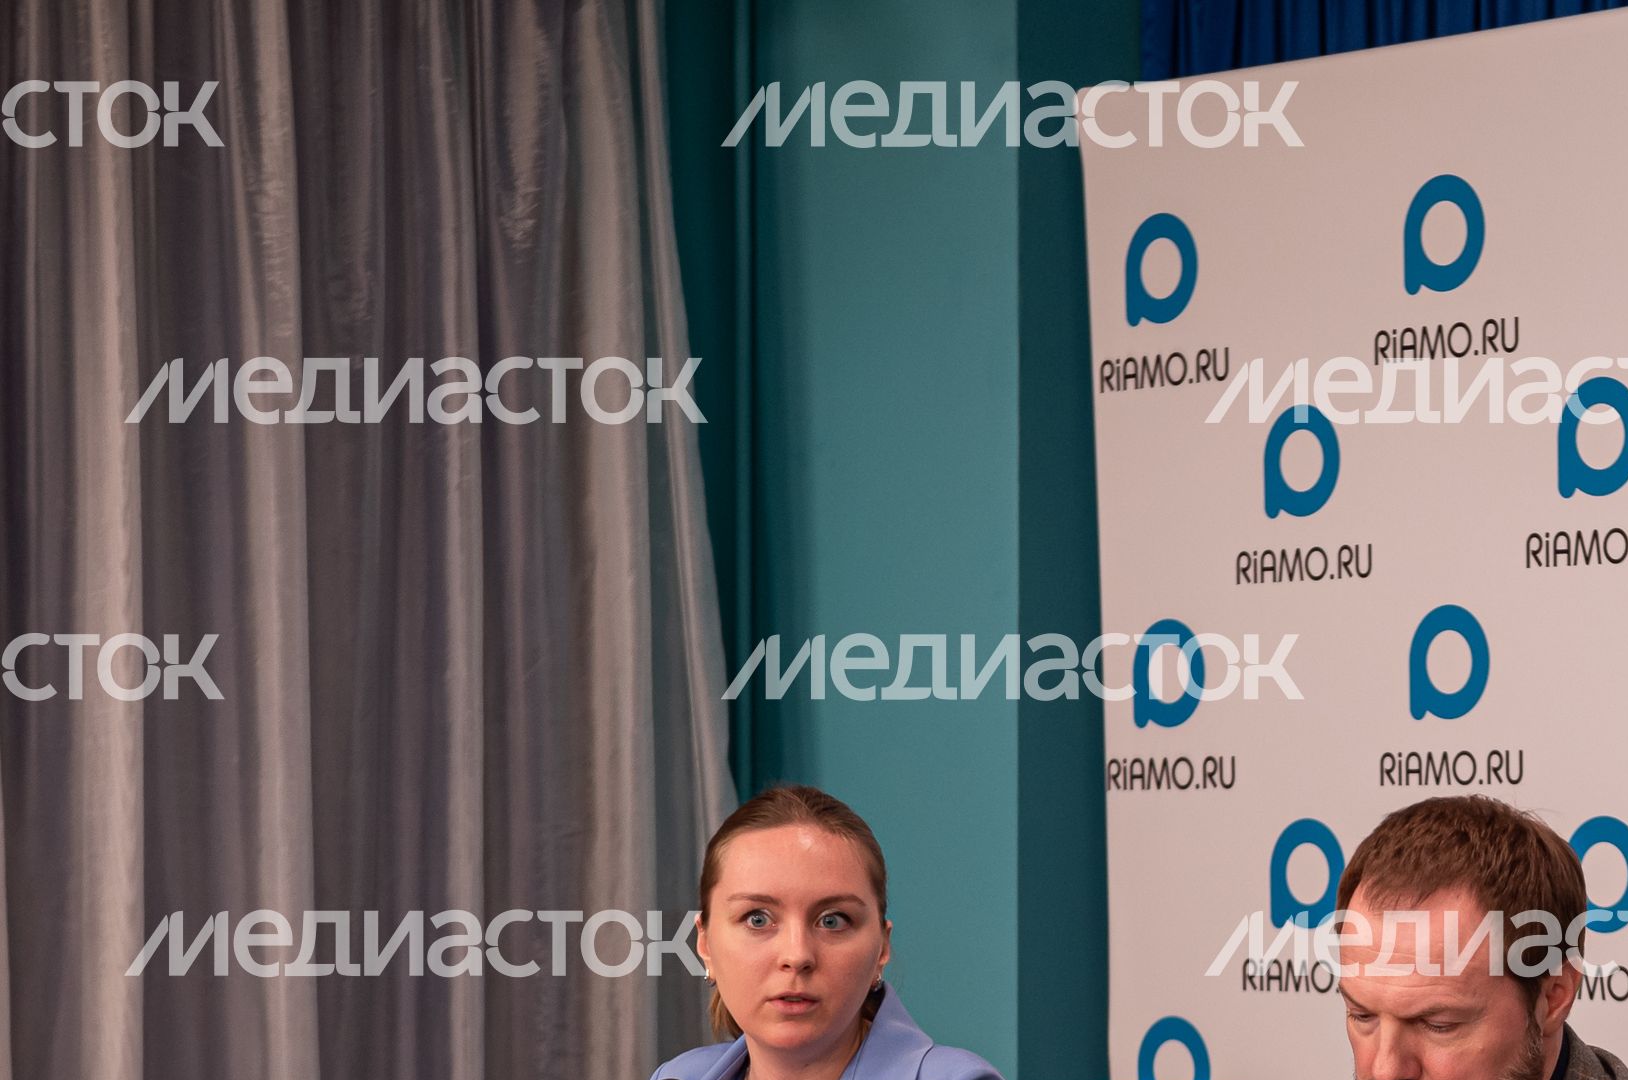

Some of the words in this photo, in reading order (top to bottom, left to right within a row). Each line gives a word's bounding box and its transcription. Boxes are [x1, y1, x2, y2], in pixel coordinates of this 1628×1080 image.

[1374, 316, 1519, 366] RiAMO.RU
[1099, 347, 1230, 394] RiAMO.RU
[1236, 544, 1373, 586] RiAMO.RU
[1107, 756, 1236, 791] RiAMO.RU
[1380, 749, 1524, 786] RiAMO.RU
[1242, 957, 1340, 994] RiAMO.
